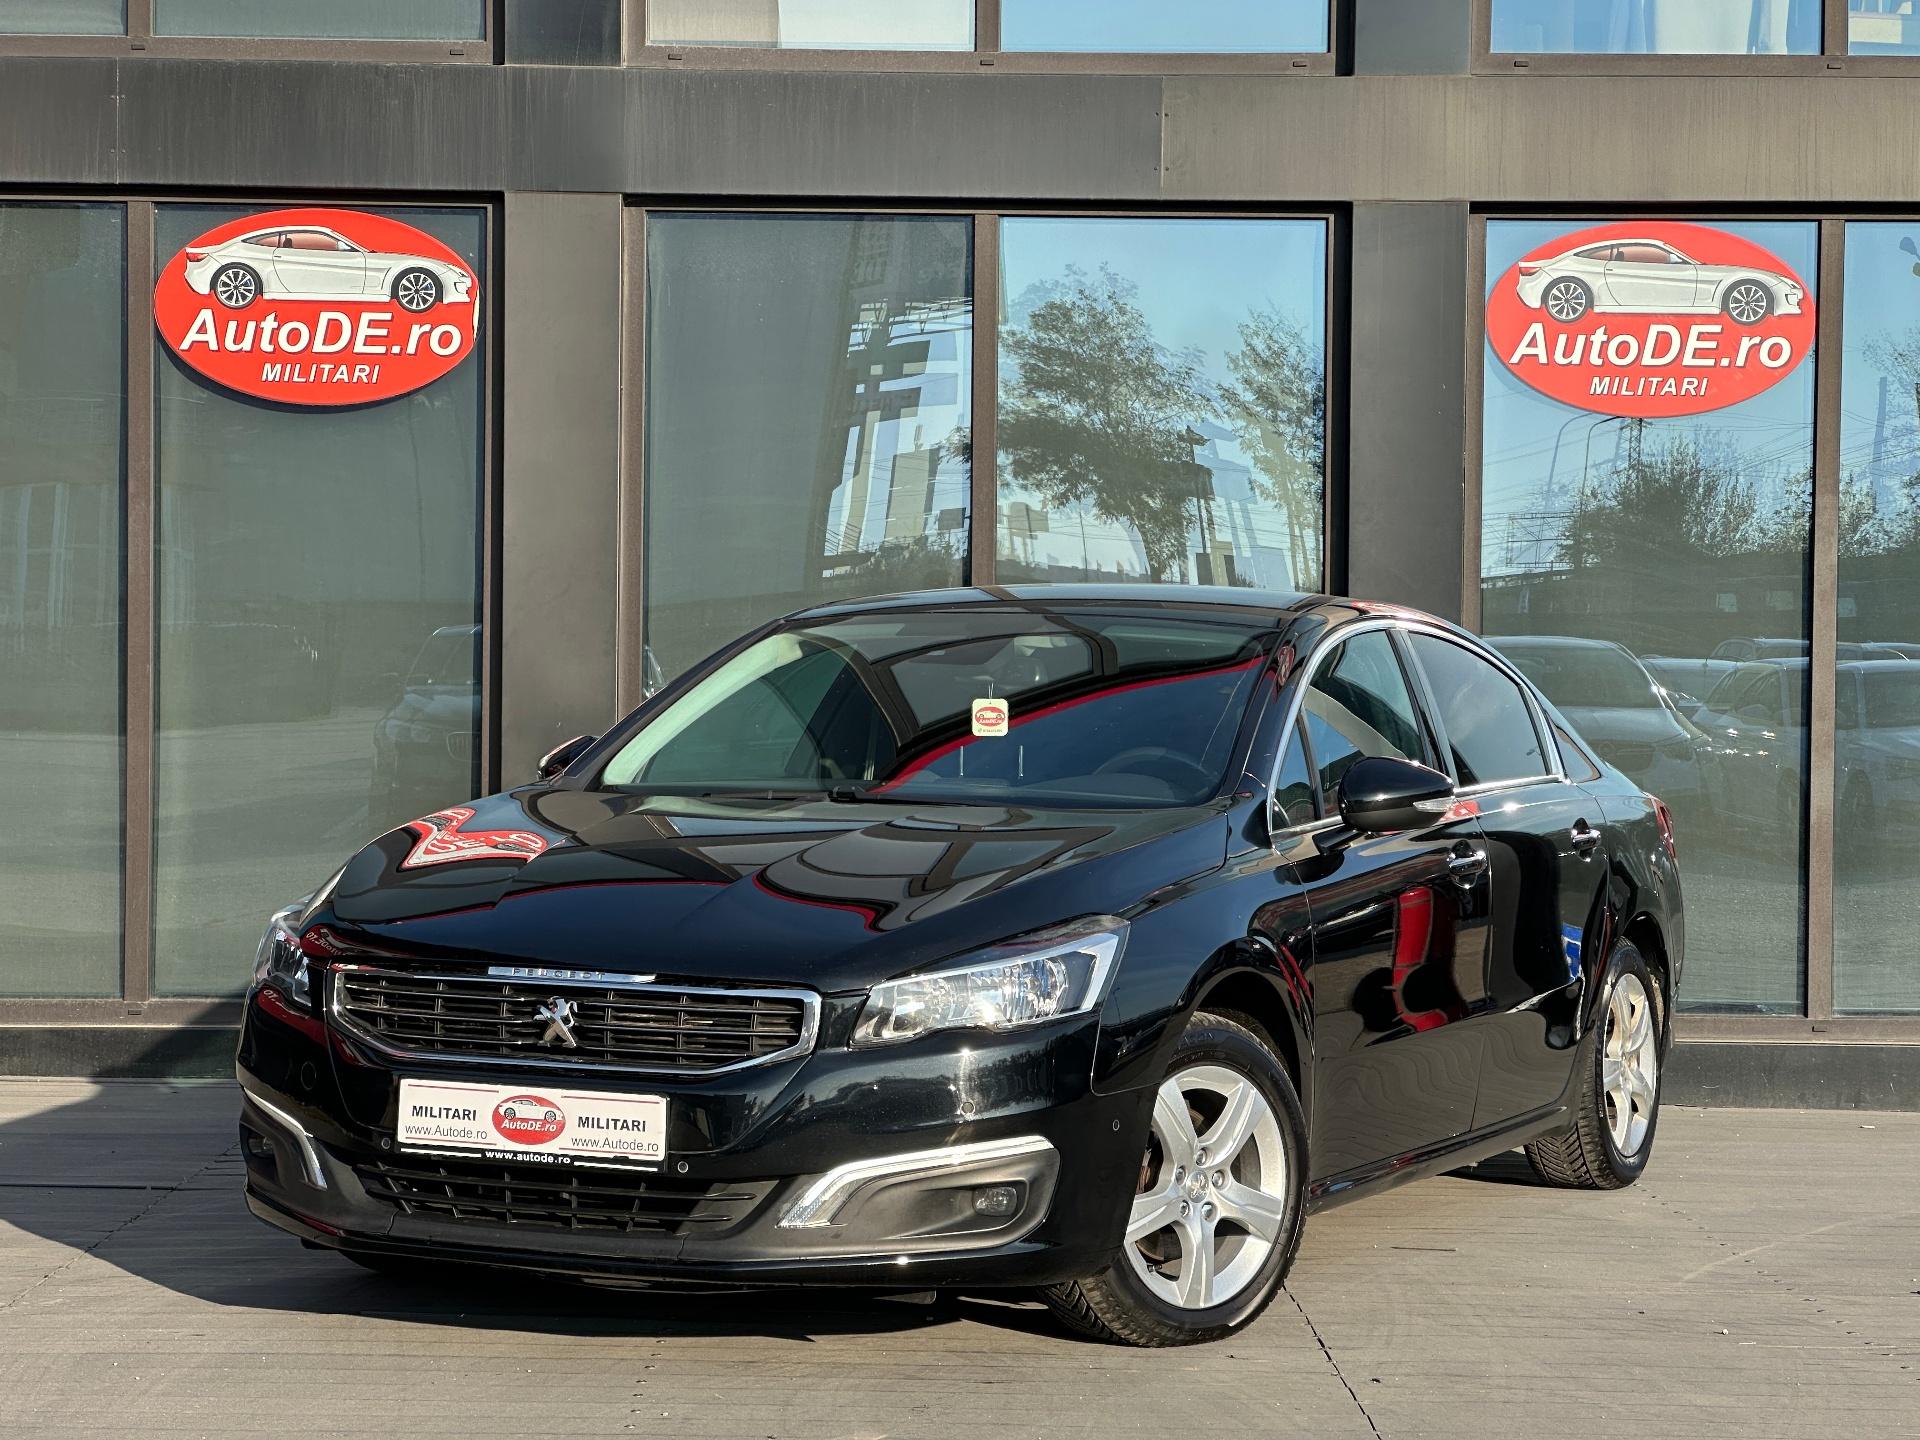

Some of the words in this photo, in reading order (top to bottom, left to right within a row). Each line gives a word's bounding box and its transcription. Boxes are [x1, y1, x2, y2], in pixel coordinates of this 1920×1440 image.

[178, 308, 462, 357] AutoDE.ro
[1508, 322, 1792, 368] AutoDE.ro
[261, 363, 381, 384] MILITARI
[1589, 376, 1709, 397] MILITARI
[411, 1105, 477, 1121] MILITARI
[501, 1119, 557, 1132] AutoDE.ro
[577, 1116, 646, 1132] MILITARI
[405, 1125, 488, 1140] www.Autode.ro
[571, 1137, 659, 1152] www.Autode.ro
[485, 1150, 571, 1164] www.autode.ro
